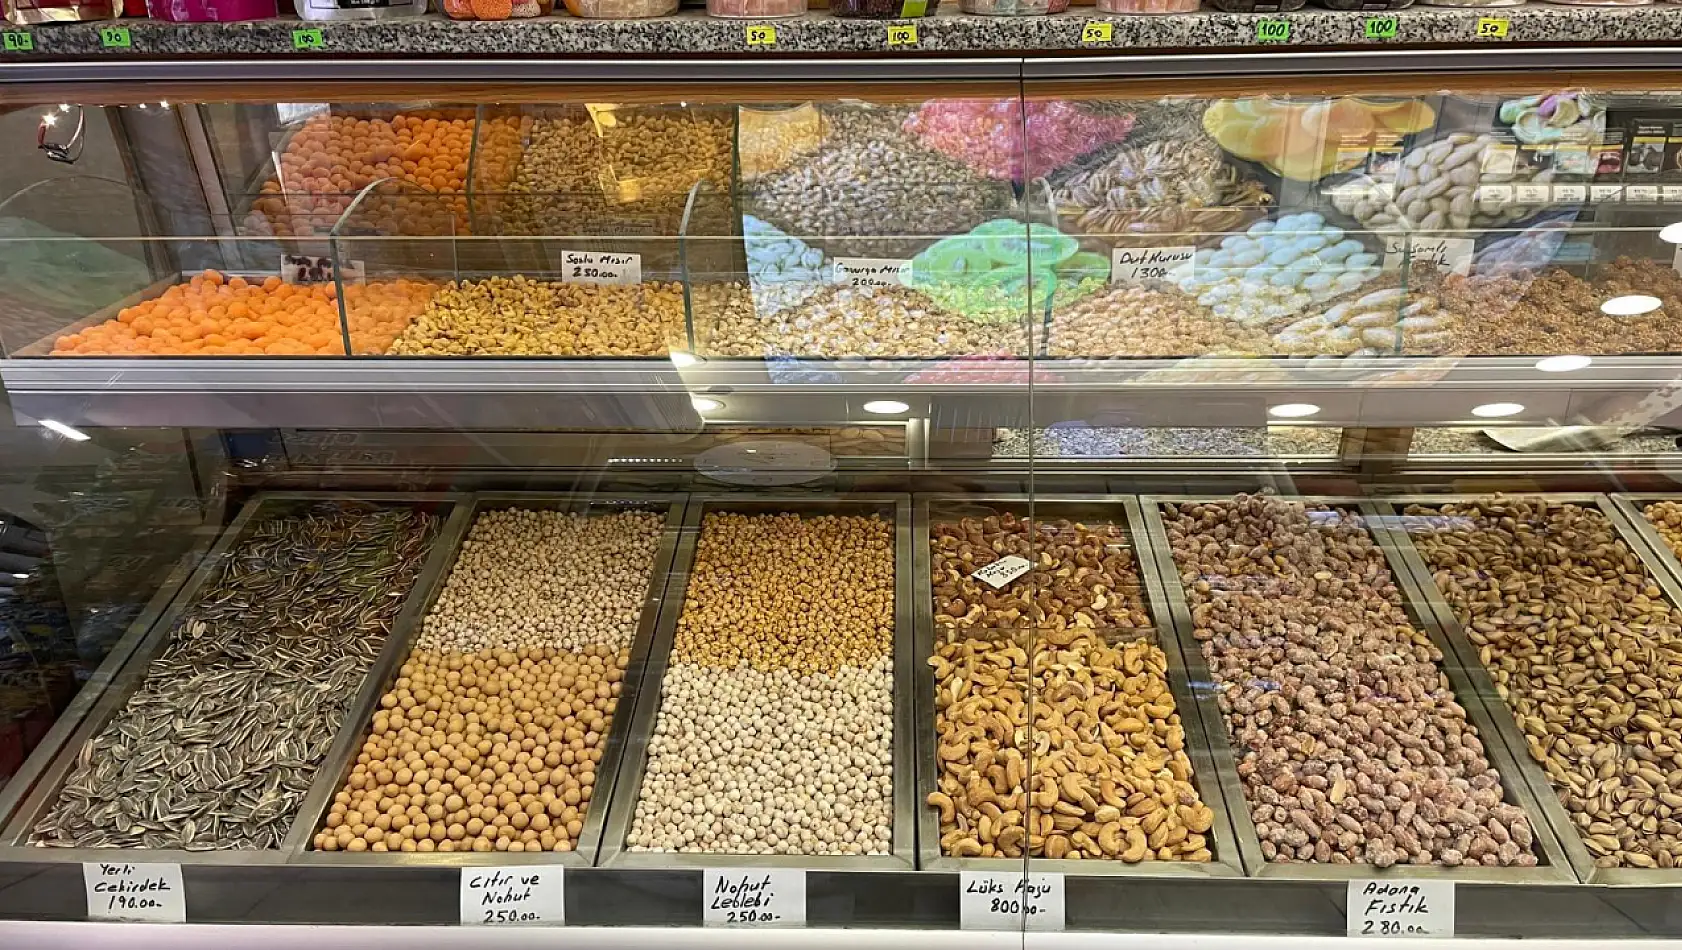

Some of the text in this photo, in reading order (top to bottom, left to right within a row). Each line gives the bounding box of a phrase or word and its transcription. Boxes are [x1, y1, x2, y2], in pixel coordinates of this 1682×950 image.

[1262, 23, 1285, 37] 100
[1370, 19, 1393, 34] 100
[1480, 23, 1499, 34] 50
[751, 30, 766, 42] 50
[892, 31, 910, 42] 100
[1085, 29, 1103, 39] 50
[1119, 249, 1148, 265] Dut
[100, 863, 135, 875] Yerli
[521, 874, 540, 885] ve
[714, 874, 771, 895] Nohut
[966, 877, 1004, 894] Lüks
[481, 886, 531, 906] Nohut
[710, 891, 774, 910] Leblebi
